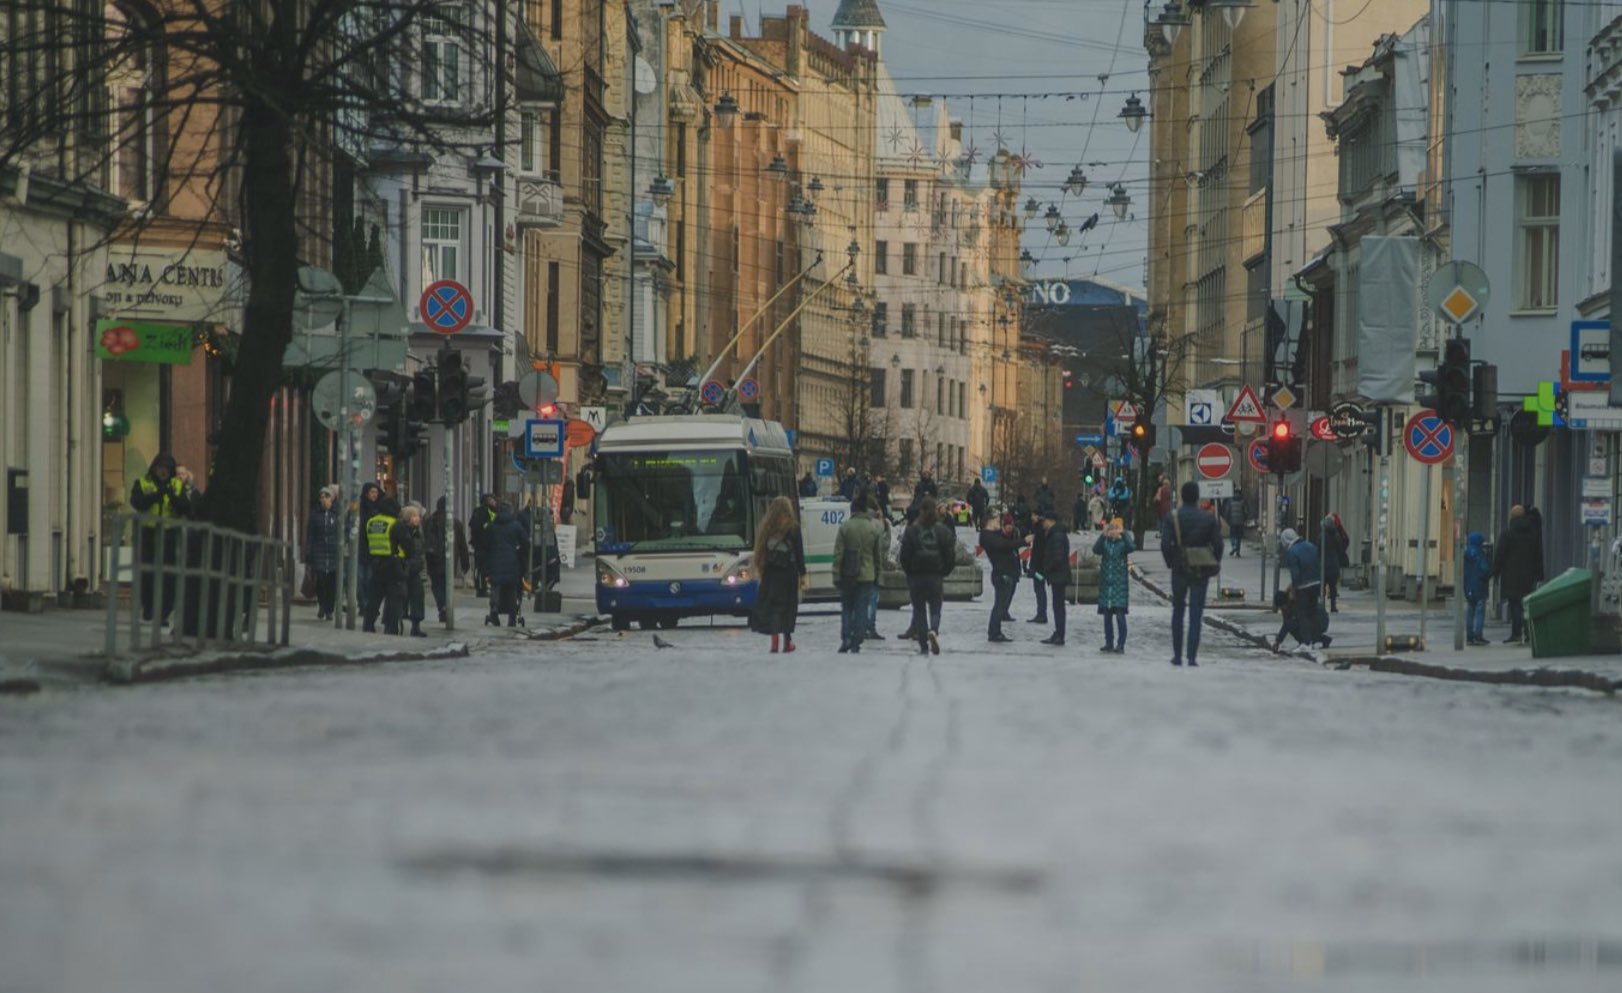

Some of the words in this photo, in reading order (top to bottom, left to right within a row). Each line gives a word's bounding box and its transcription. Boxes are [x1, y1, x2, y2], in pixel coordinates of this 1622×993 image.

[162, 264, 223, 288] CENTRS
[1032, 282, 1071, 304] NO
[819, 461, 830, 474] P
[984, 468, 993, 479] P
[821, 510, 845, 525] 402
